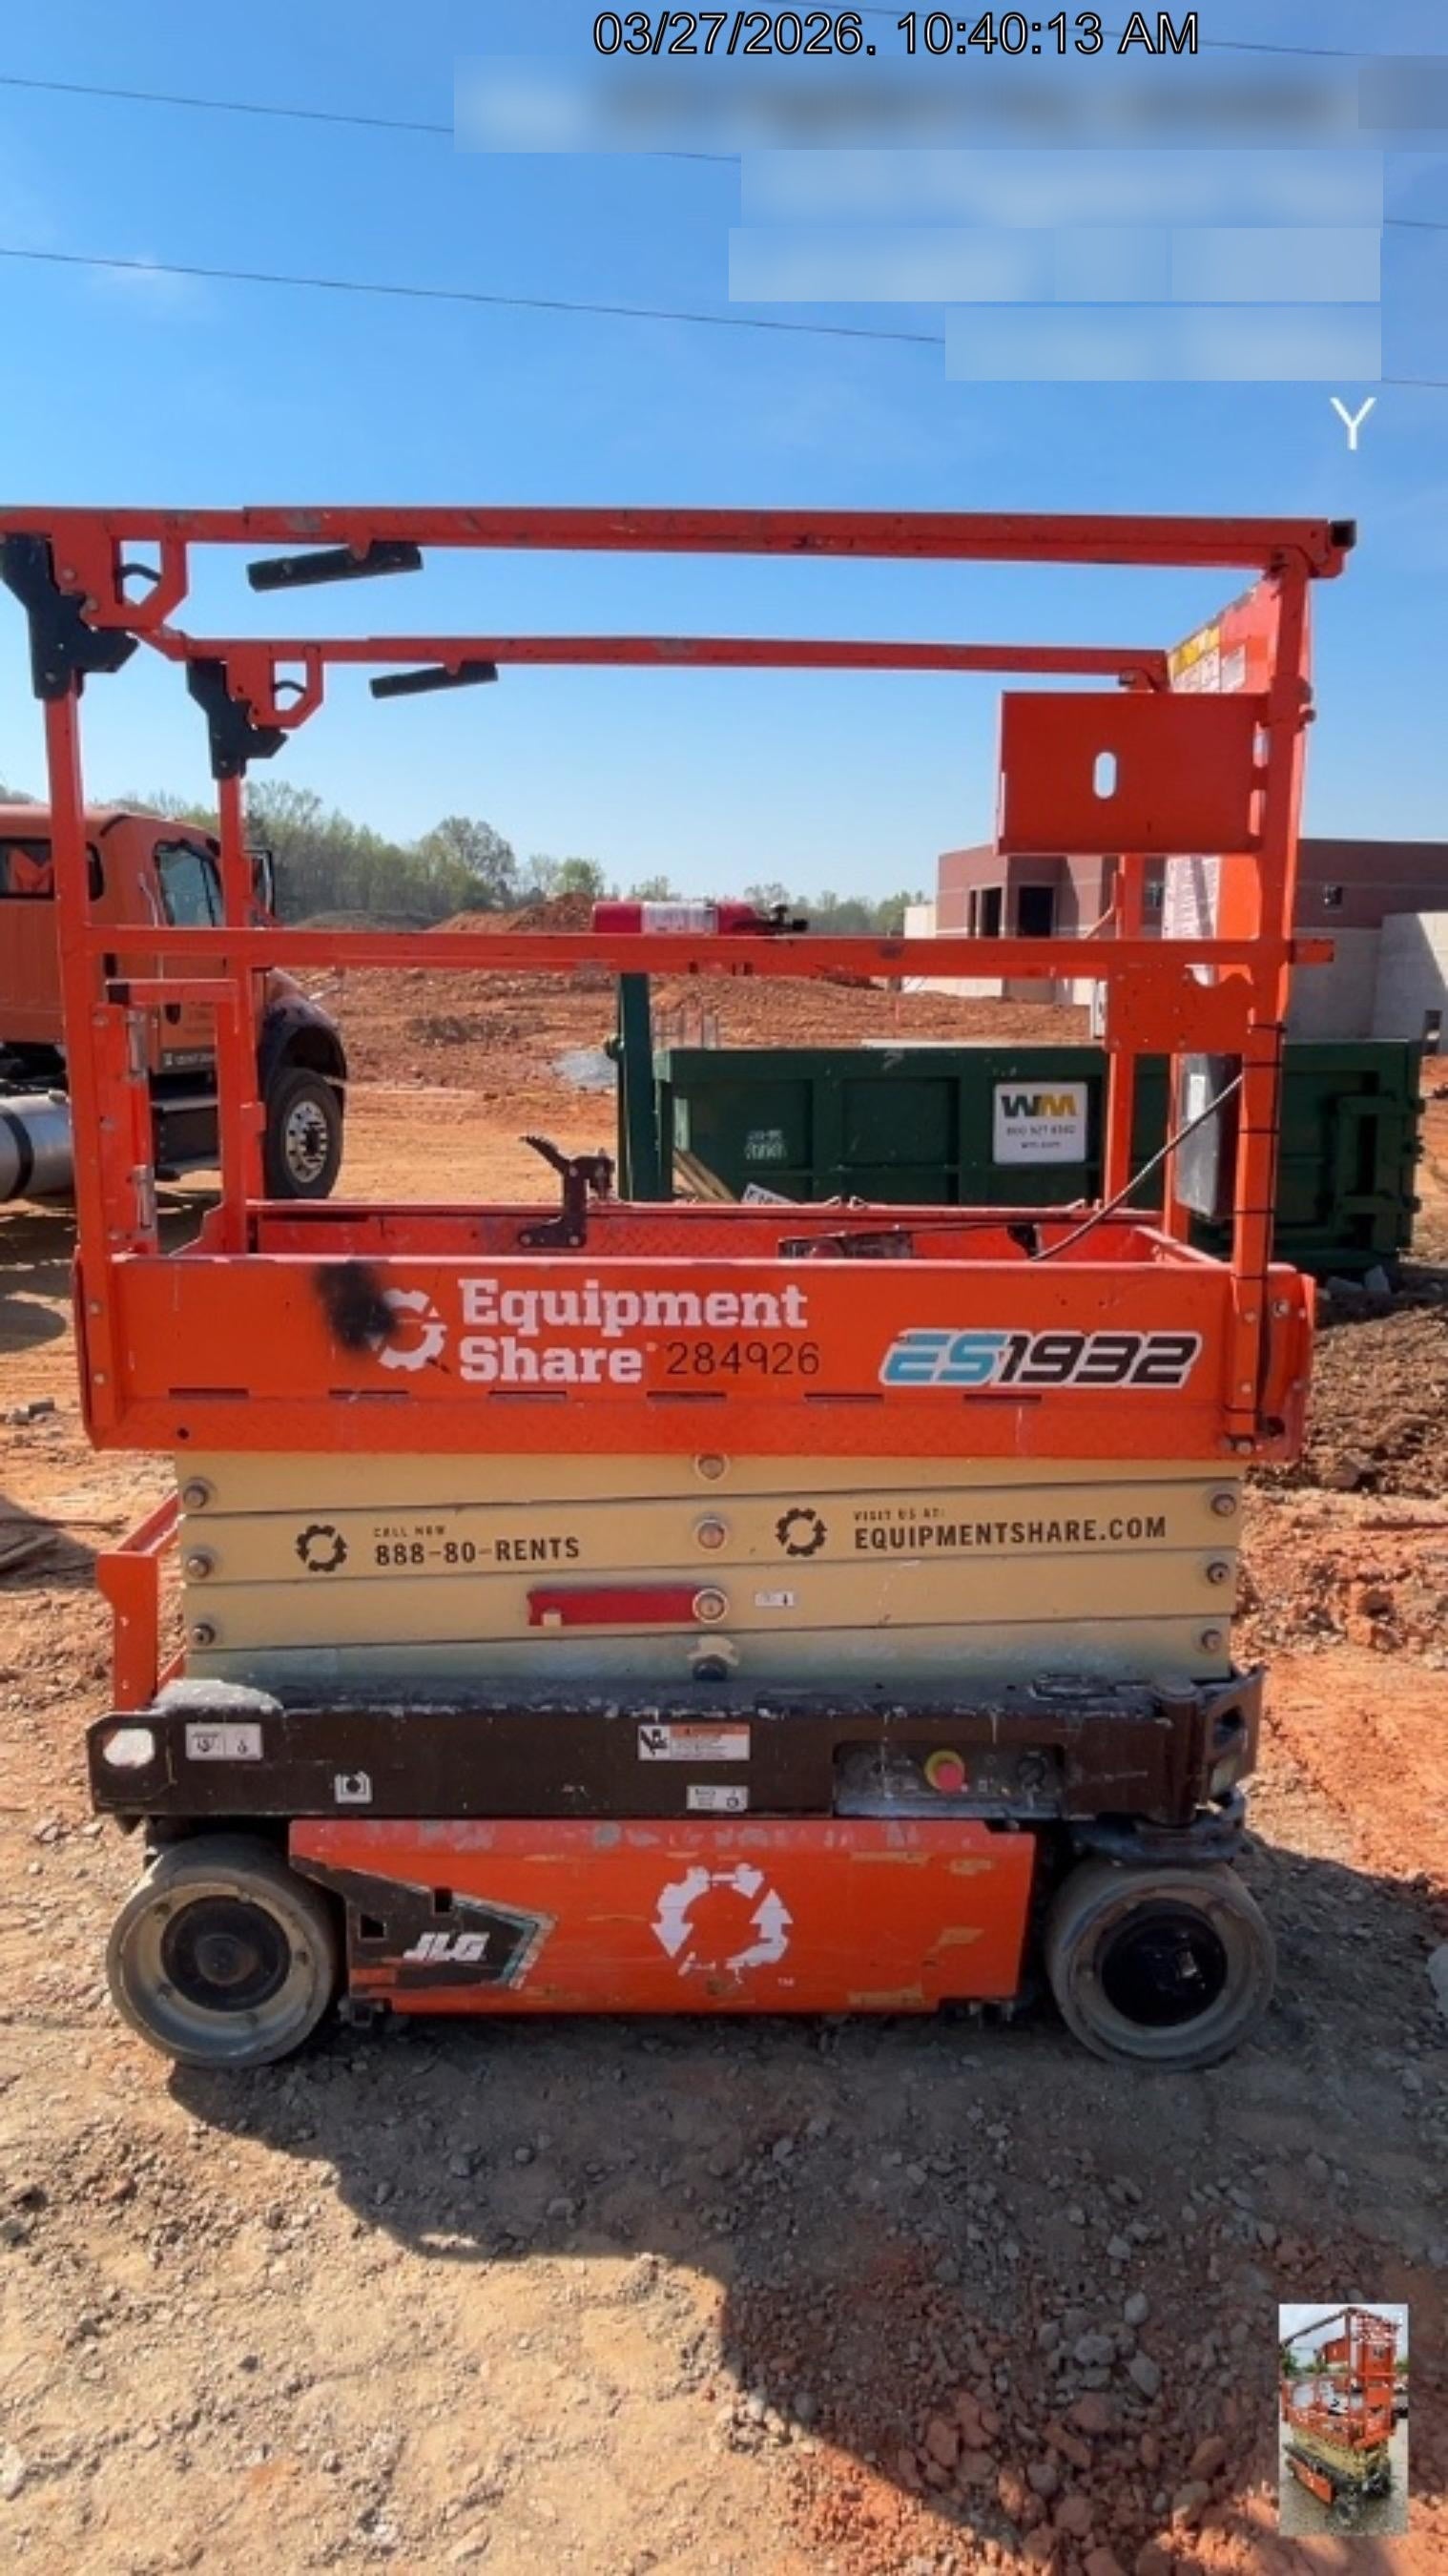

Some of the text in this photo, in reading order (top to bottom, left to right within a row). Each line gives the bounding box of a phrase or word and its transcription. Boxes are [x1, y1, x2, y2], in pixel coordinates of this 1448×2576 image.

[1002, 1094, 1077, 1116] WM
[458, 1278, 808, 1336] Equipment
[459, 1337, 642, 1382] Share
[666, 1341, 819, 1375] 284926
[880, 1329, 1201, 1388] ES1932
[855, 1516, 1166, 1550] EQUIPMENTSHARE.COM
[375, 1536, 580, 1566] 888-80-RENTS
[403, 1931, 489, 1962] JLG
